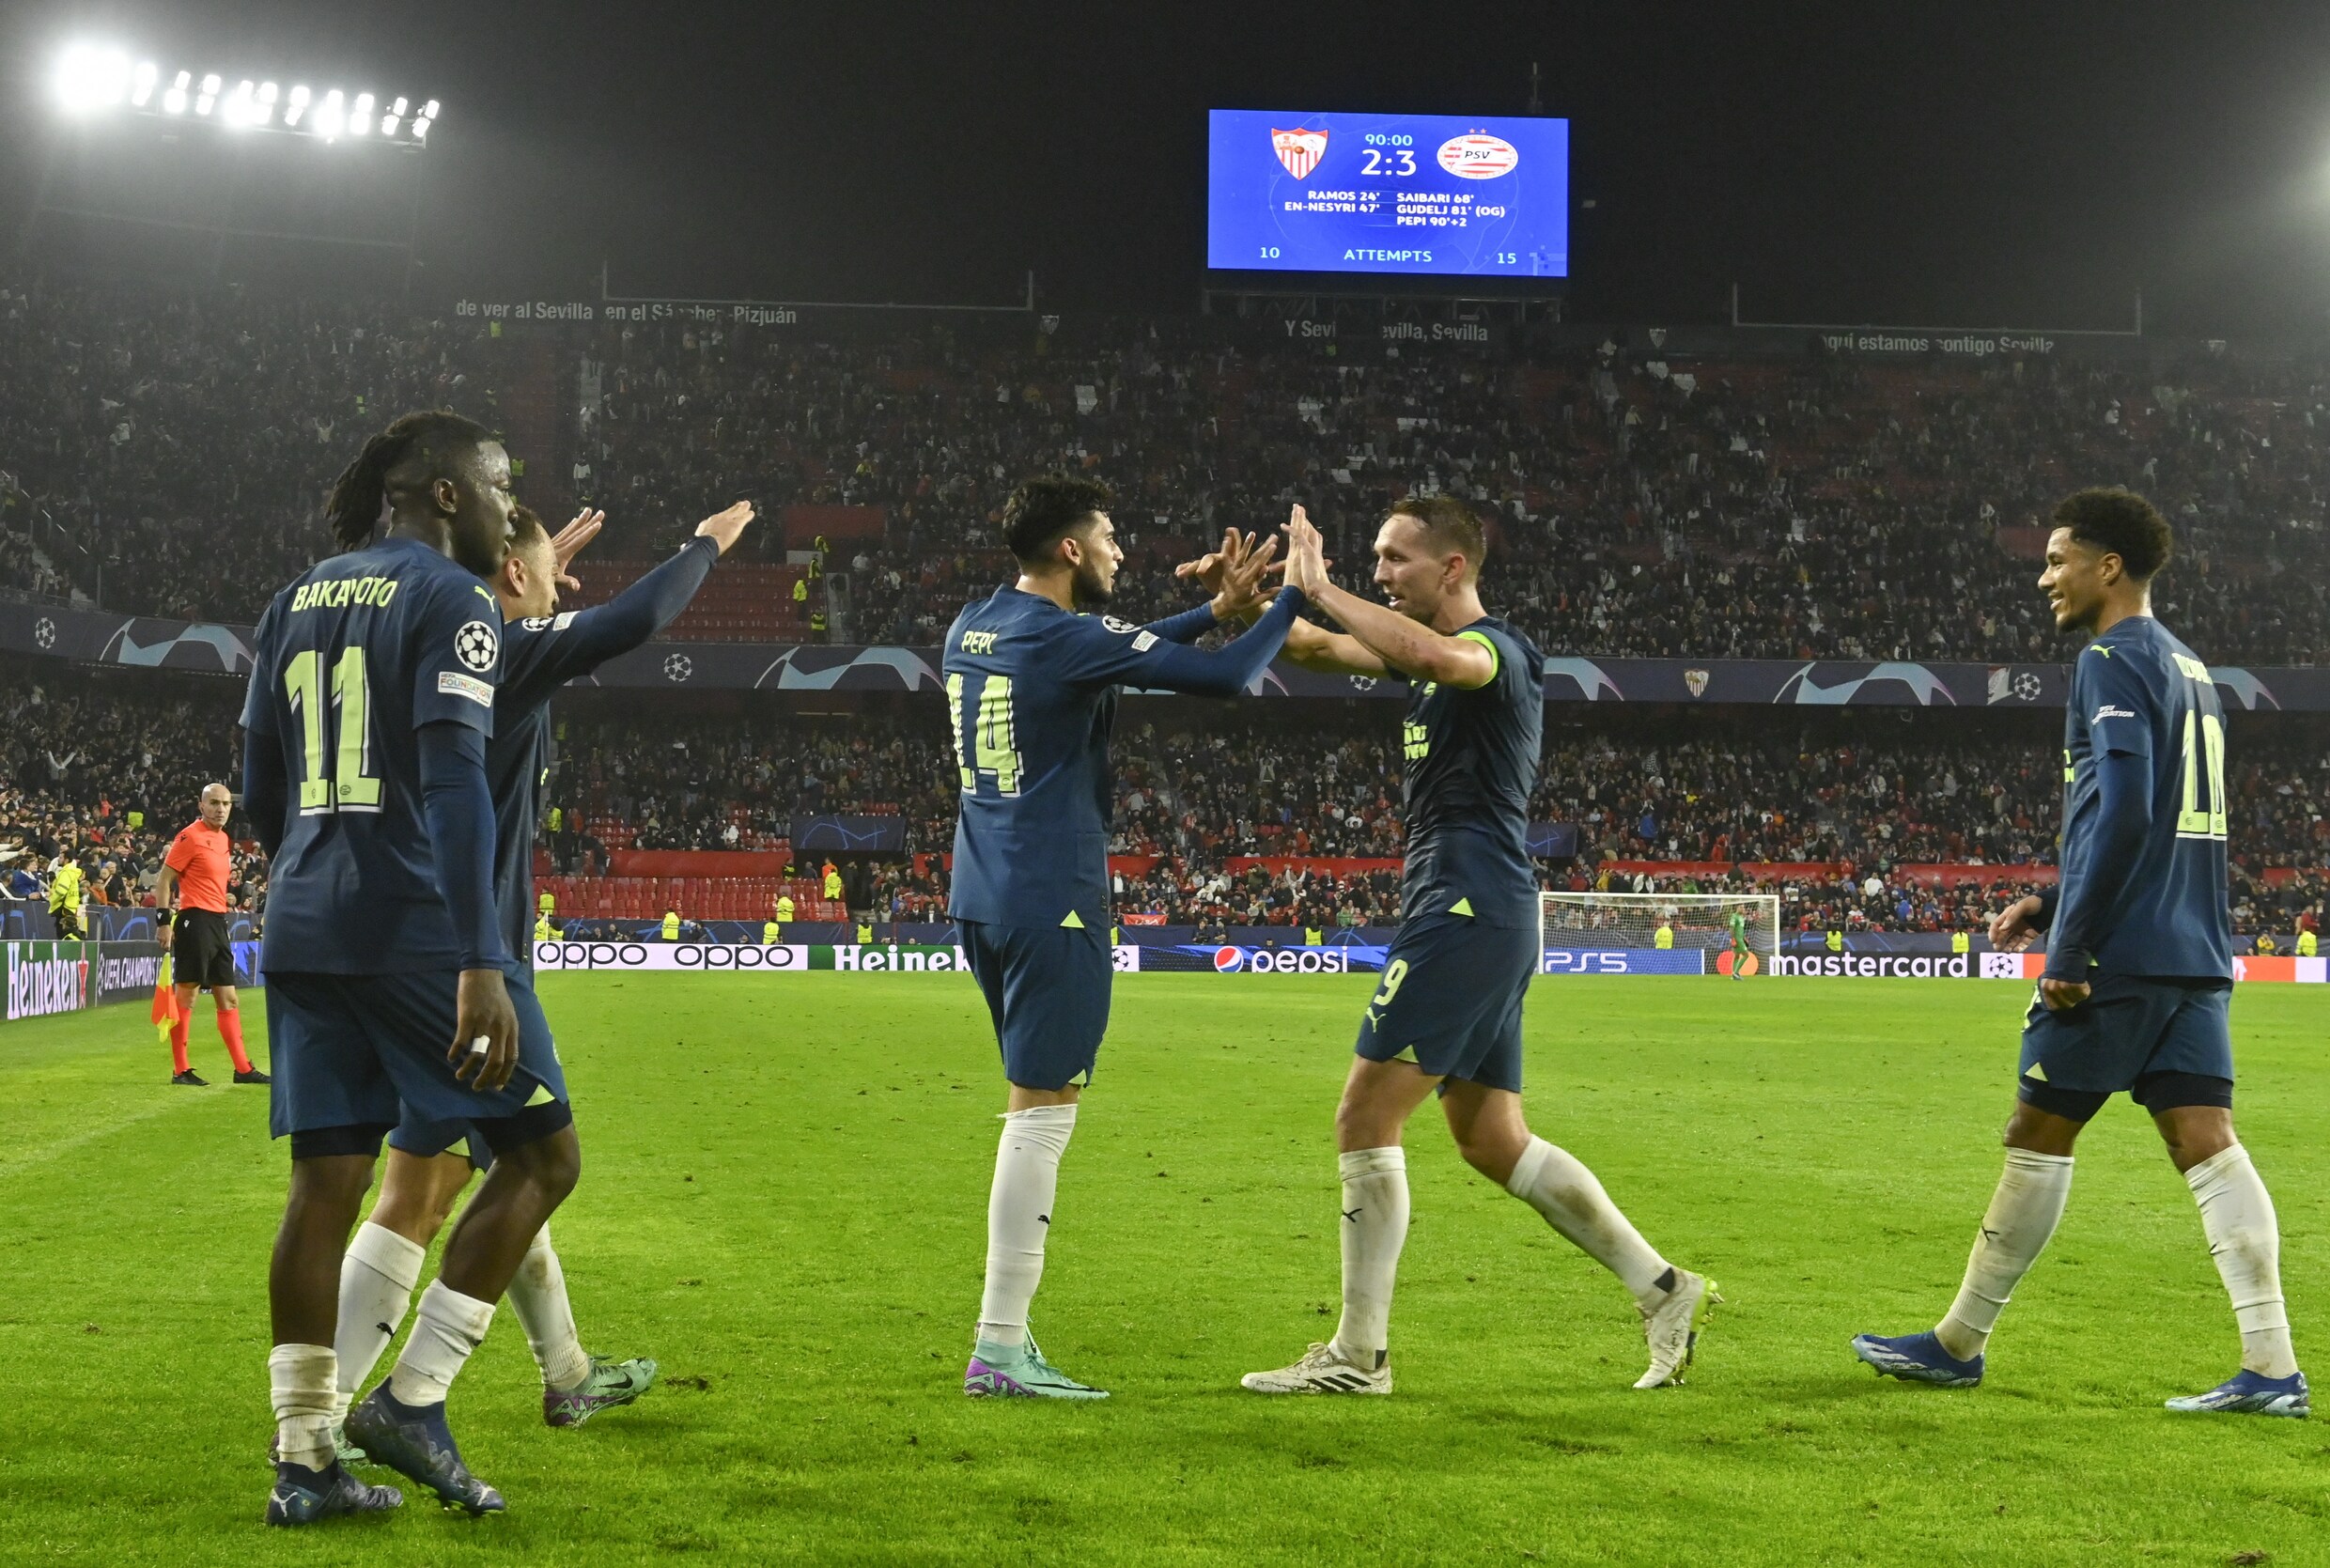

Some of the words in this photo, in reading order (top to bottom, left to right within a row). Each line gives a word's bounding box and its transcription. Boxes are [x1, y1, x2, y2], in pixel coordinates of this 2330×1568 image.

[1365, 134, 1413, 147] 90:00
[1361, 149, 1417, 176] 2:3
[1465, 150, 1490, 160] PSV
[1308, 191, 1356, 201] RAMOS
[1359, 192, 1380, 201] 24'
[1397, 193, 1450, 203] SAIBARI
[1453, 194, 1475, 204] 68'
[1284, 202, 1356, 212] EN-NESYRI
[1359, 203, 1380, 213] 47'
[1397, 204, 1448, 216] GUDELJ
[1451, 206, 1472, 215] 81'
[1476, 206, 1505, 218] (OG)
[1397, 216, 1427, 225] PEPI
[1430, 217, 1468, 227] 90'+2
[1260, 247, 1280, 258] 10
[1344, 249, 1433, 262] ATTEMPTS
[1498, 253, 1517, 264] 15
[457, 300, 476, 316] de
[482, 303, 508, 317] ver
[516, 302, 530, 318] al
[535, 302, 593, 320] Sevilla
[605, 306, 627, 320] en
[630, 303, 645, 320] el
[1284, 319, 1297, 336] Y
[1432, 323, 1488, 340] Sevilla
[1859, 334, 1929, 351] estamos
[961, 630, 998, 655] PEPI
[441, 678, 491, 700] FOUNDATION
[284, 645, 384, 815] 11
[945, 673, 1024, 798] 14
[537, 941, 647, 970] oppo
[675, 944, 793, 970] oppo
[832, 944, 971, 971] Heinek
[1251, 945, 1348, 972] pepsi
[1546, 953, 1627, 972] PS5
[1769, 953, 1969, 977] mastercard
[7, 942, 78, 1019] Heineken
[1374, 959, 1408, 1005] 9
